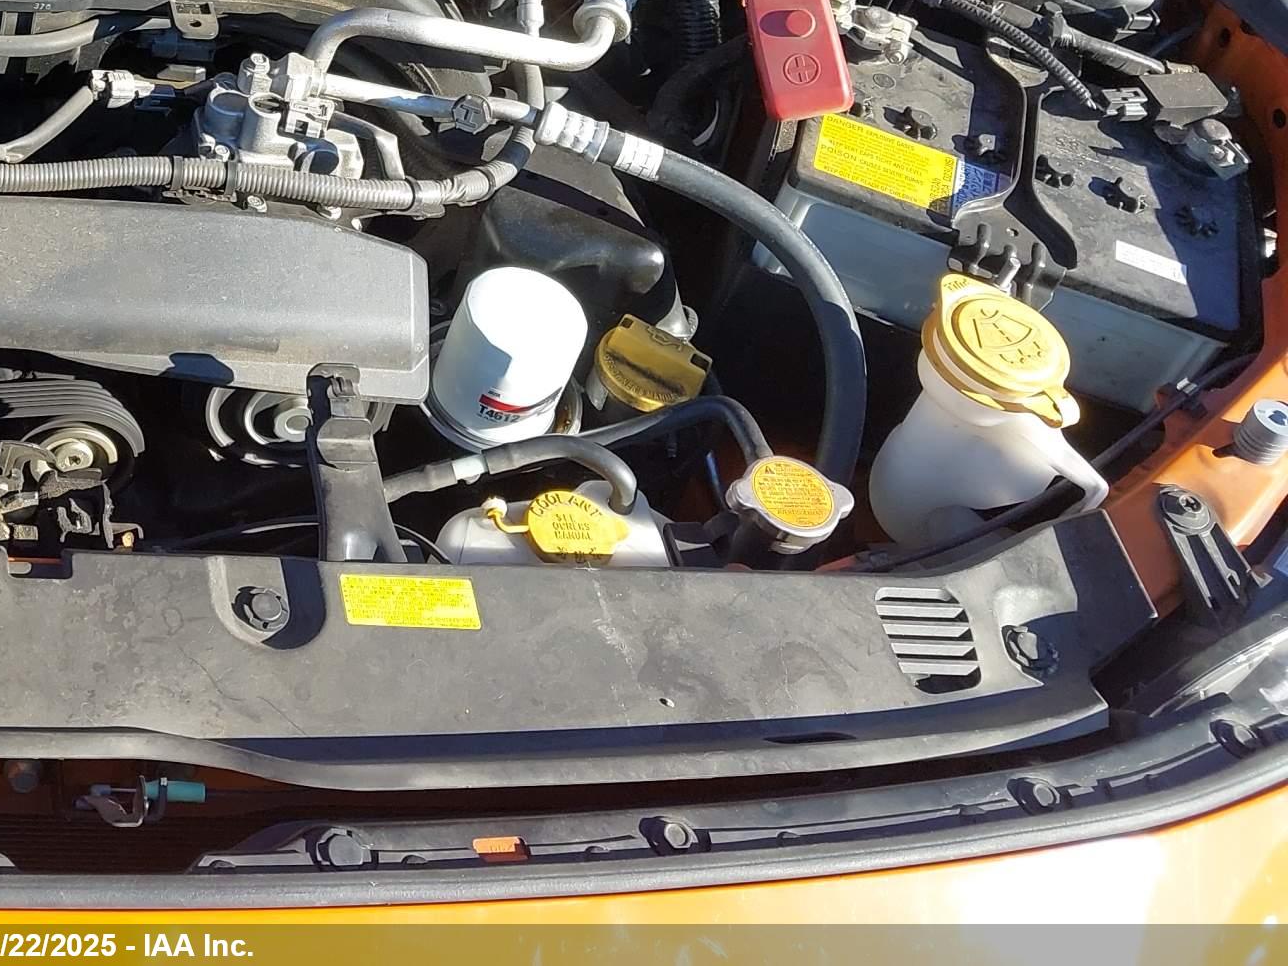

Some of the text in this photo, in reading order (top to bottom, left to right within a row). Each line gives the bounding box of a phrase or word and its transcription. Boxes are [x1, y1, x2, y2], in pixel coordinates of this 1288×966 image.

[826, 116, 864, 133] DANGER
[820, 143, 858, 163] POISON
[529, 492, 603, 518] COOLANT
